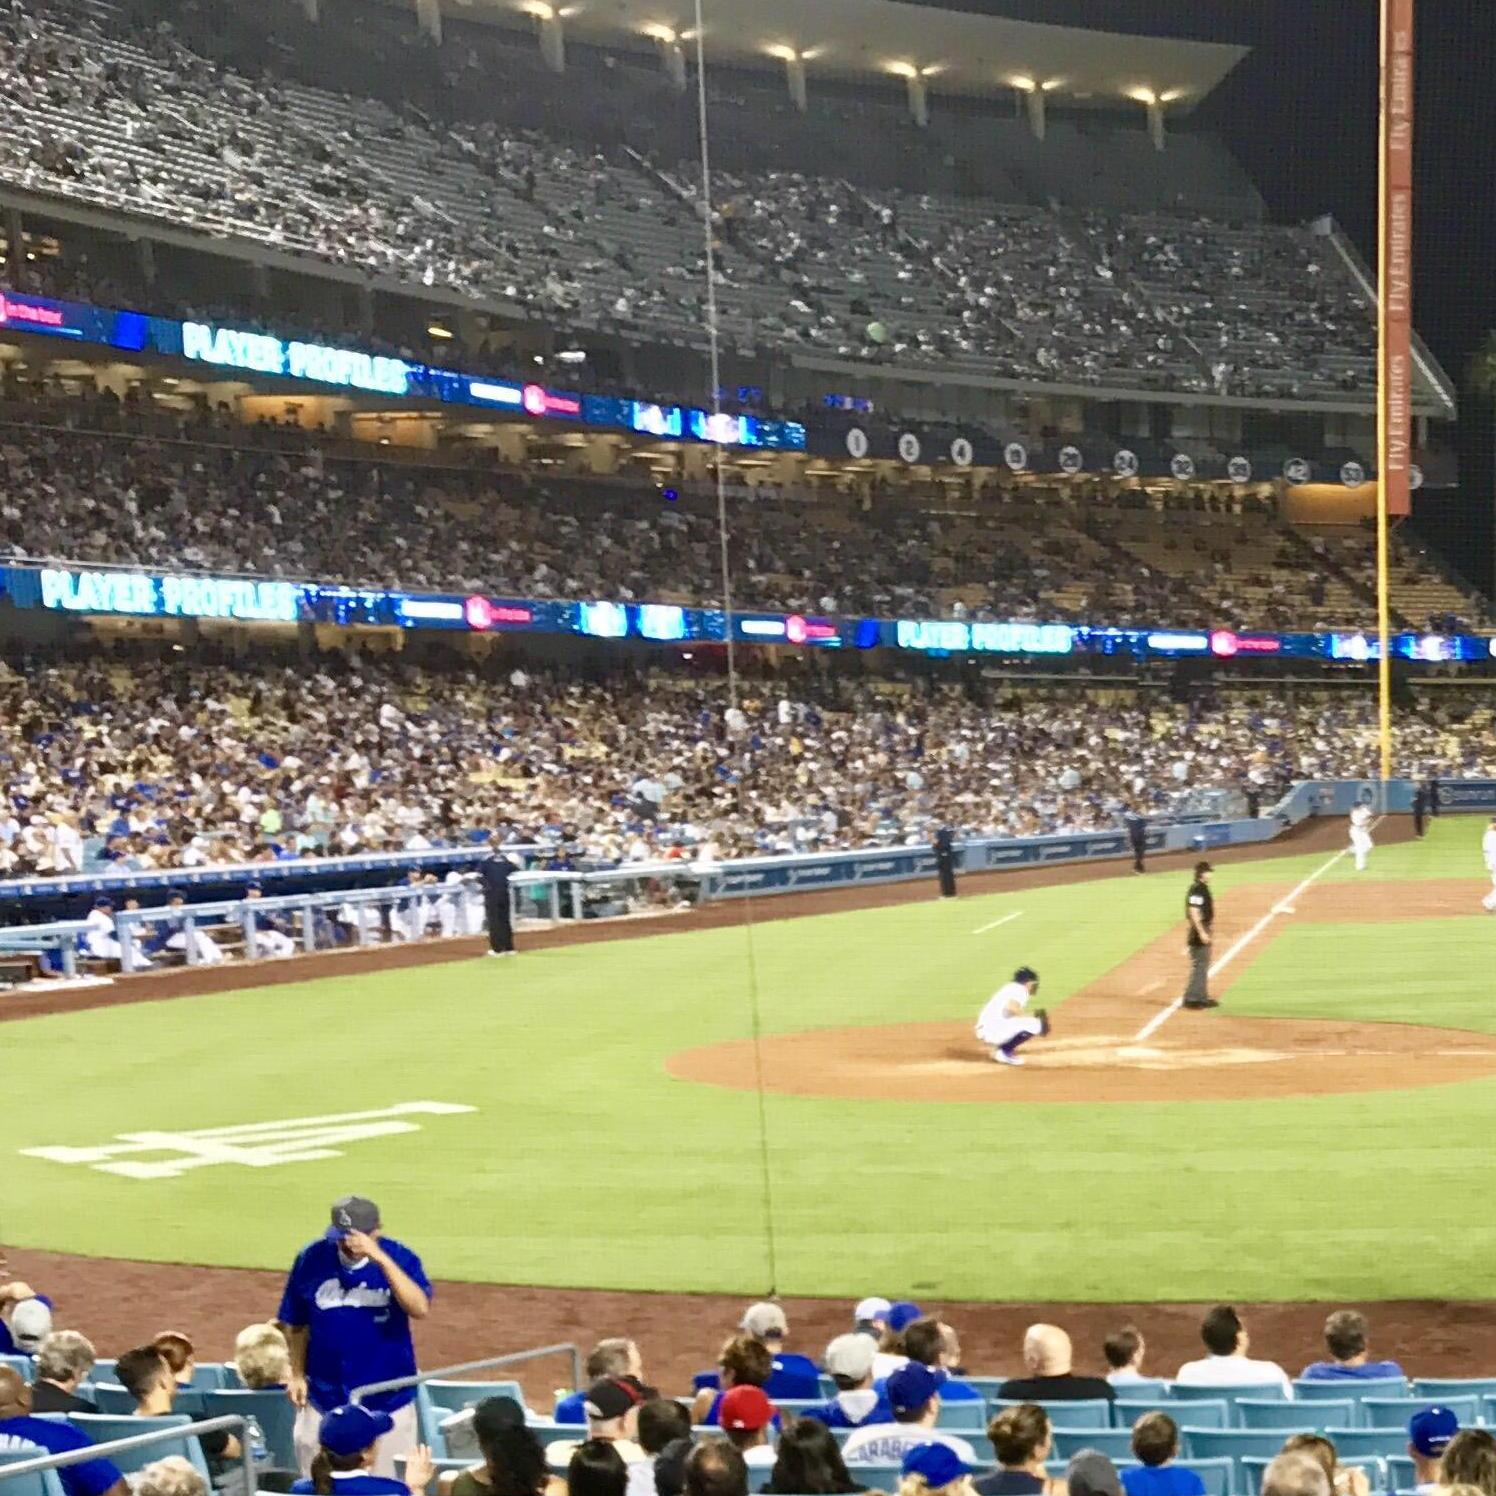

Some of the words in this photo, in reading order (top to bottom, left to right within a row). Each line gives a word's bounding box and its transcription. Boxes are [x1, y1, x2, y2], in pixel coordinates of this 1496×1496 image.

[1391, 31, 1408, 114] Emiraes
[1390, 193, 1406, 274] Emirates
[1389, 280, 1409, 311] Fly
[182, 321, 283, 374] PLAYER
[287, 340, 408, 394] PROFILES
[1388, 355, 1404, 435] Emirates
[1388, 440, 1408, 470] Fly
[40, 568, 156, 614] PLAYER
[162, 576, 299, 620] PROFILES
[898, 620, 969, 649] PLAYER
